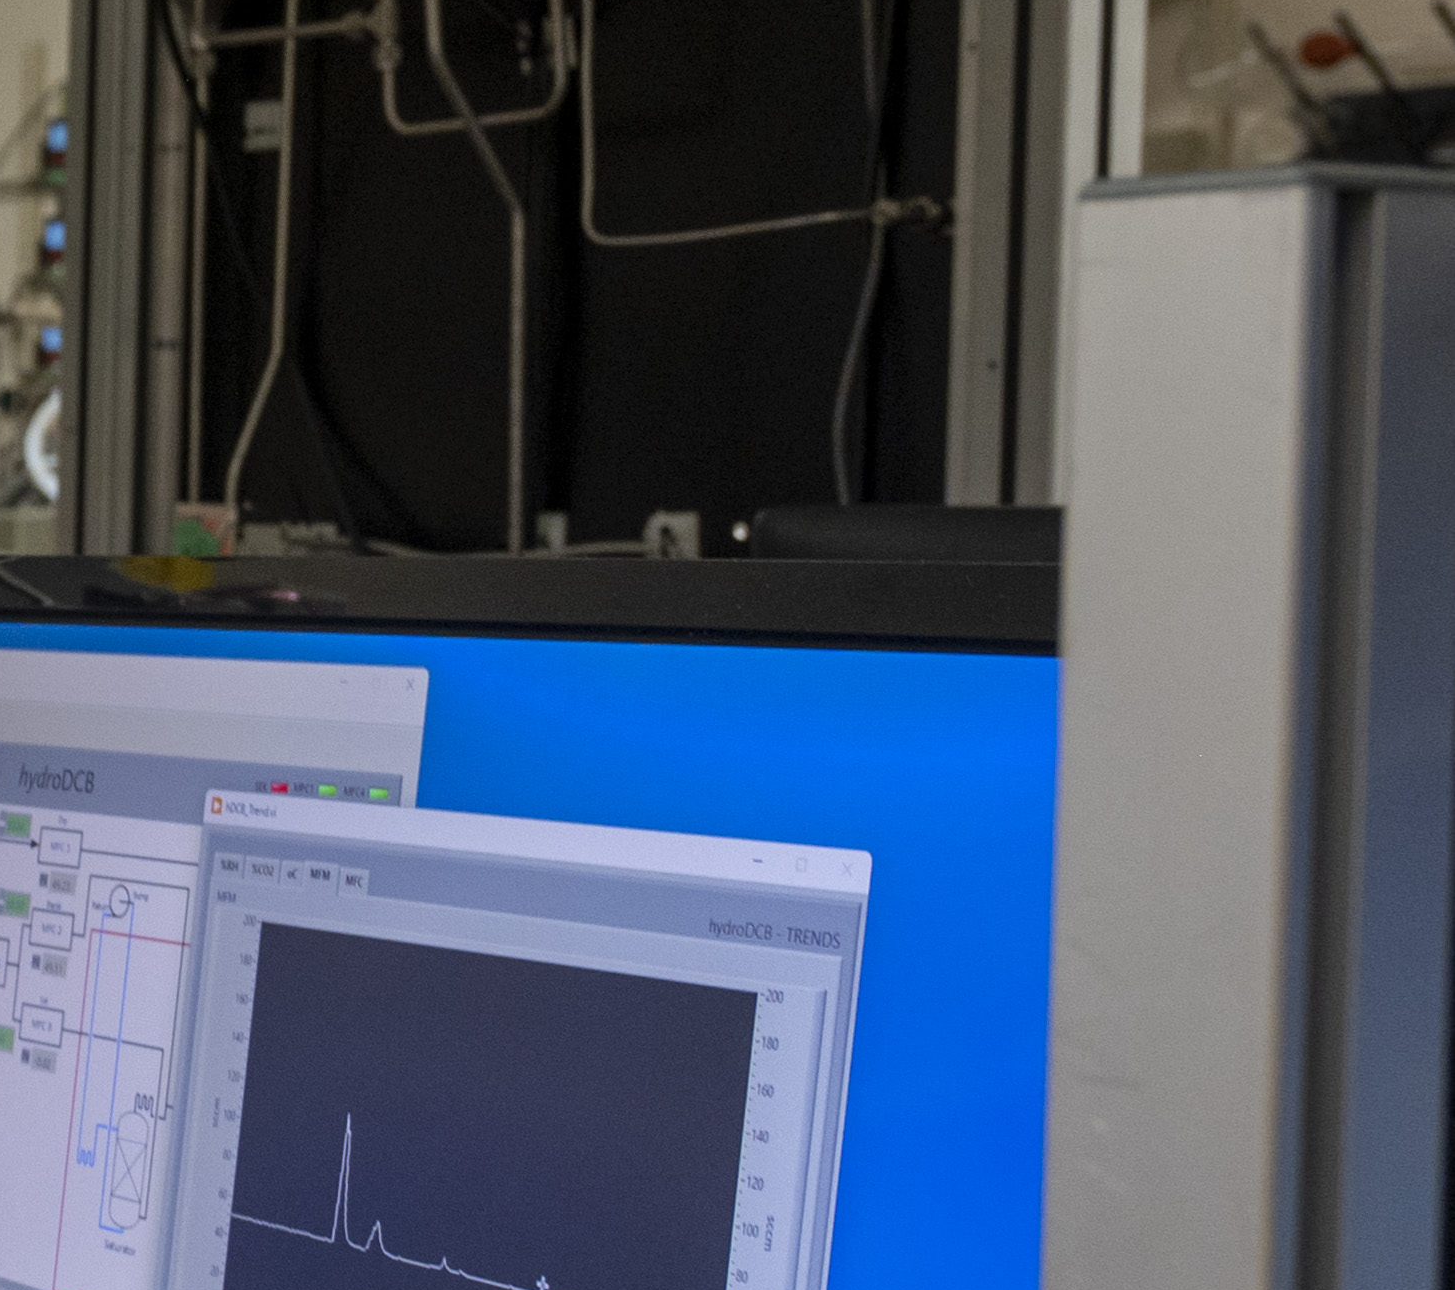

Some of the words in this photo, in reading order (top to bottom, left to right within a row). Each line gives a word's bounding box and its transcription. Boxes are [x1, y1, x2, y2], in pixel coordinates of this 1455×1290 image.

[19, 764, 95, 794] hydroDCB
[309, 867, 333, 883] MFM
[345, 874, 364, 890] MFC
[708, 917, 774, 940] hydroDCB
[787, 925, 842, 950] TRENDS
[766, 988, 784, 1005] 200
[761, 1035, 780, 1051] 180
[756, 1082, 775, 1098] 160
[752, 1128, 770, 1144] 140
[746, 1174, 765, 1192] 120
[741, 1221, 760, 1239] 100
[763, 1214, 775, 1253] sccm
[735, 1268, 750, 1285] 80
